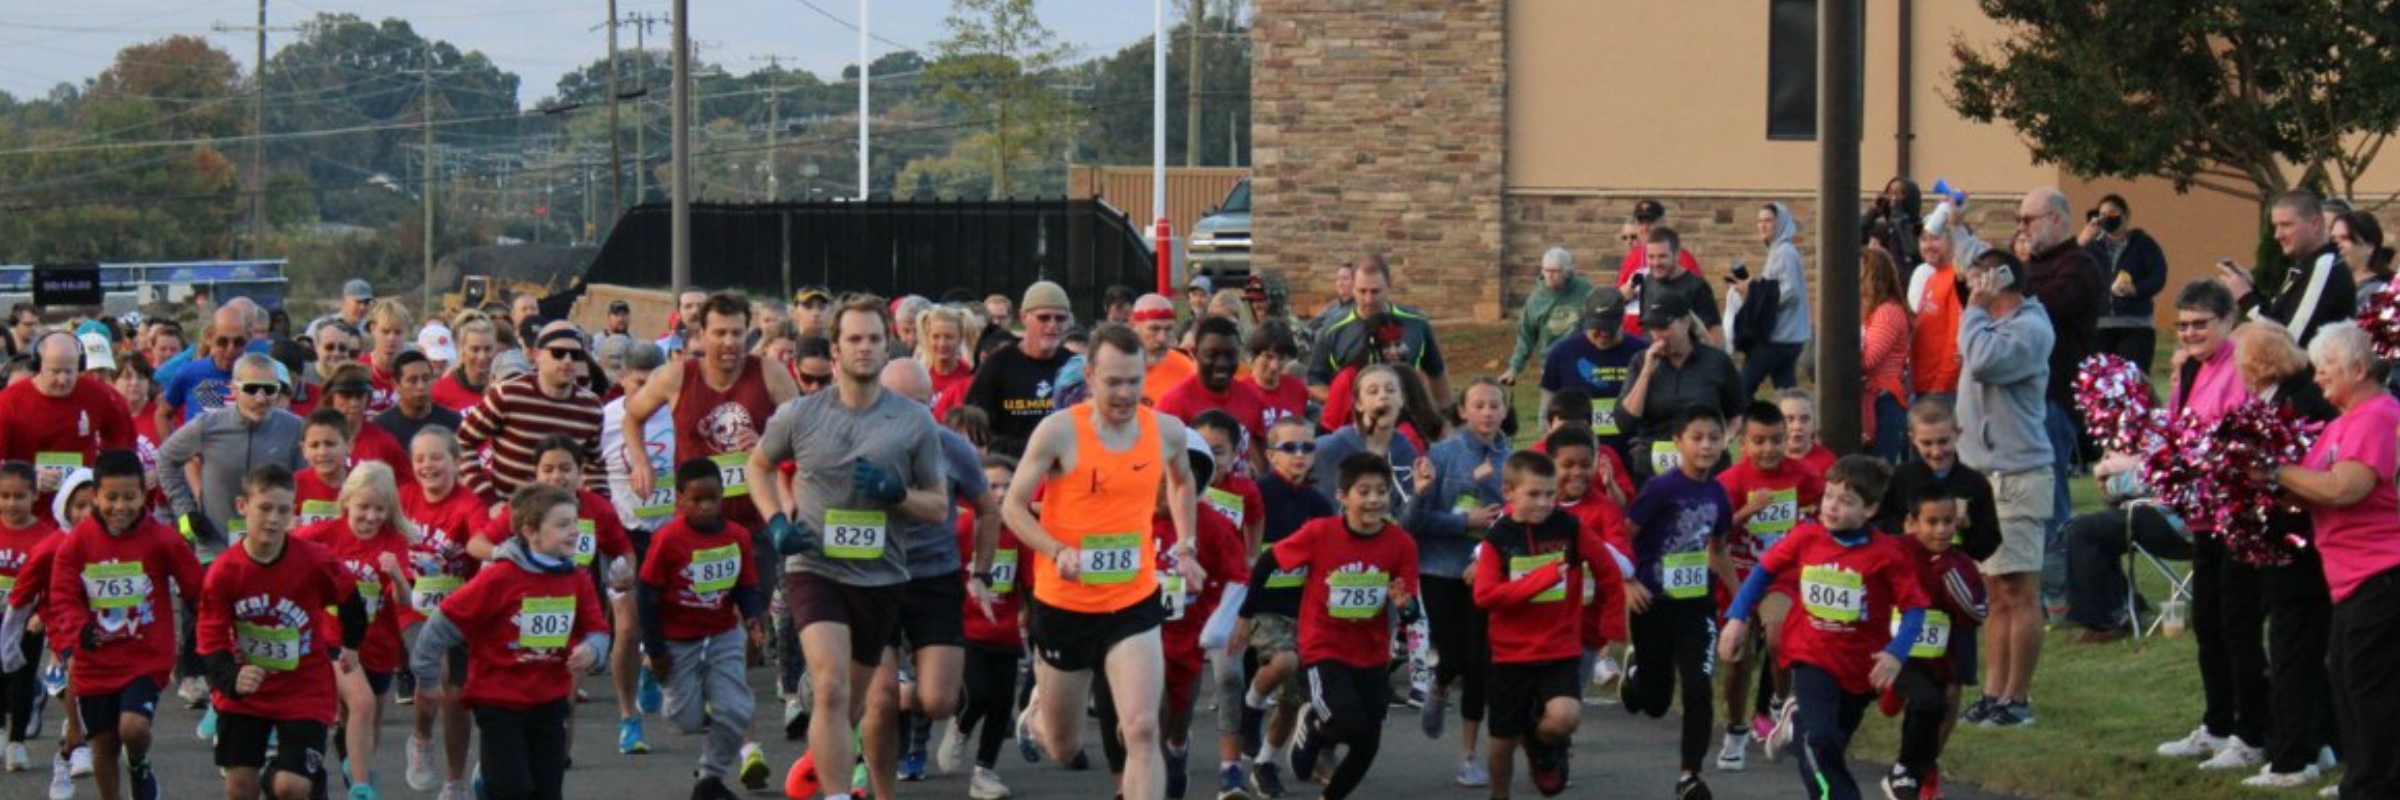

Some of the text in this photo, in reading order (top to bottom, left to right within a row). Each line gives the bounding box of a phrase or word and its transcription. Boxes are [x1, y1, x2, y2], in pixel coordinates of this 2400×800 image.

[1595, 413, 1614, 424] 82
[1660, 454, 1677, 467] 83
[724, 467, 746, 484] 71
[642, 489, 672, 506] 72
[1757, 503, 1791, 522] 626
[835, 526, 876, 546] 829
[1091, 549, 1132, 571] 818
[704, 560, 735, 581] 819
[991, 565, 1011, 580] 41
[1673, 568, 1702, 586] 836
[95, 578, 134, 597] 763
[1809, 584, 1849, 608] 804
[421, 592, 453, 608] 70
[1339, 588, 1378, 606] 785
[531, 614, 569, 635] 803
[247, 639, 288, 660] 733
